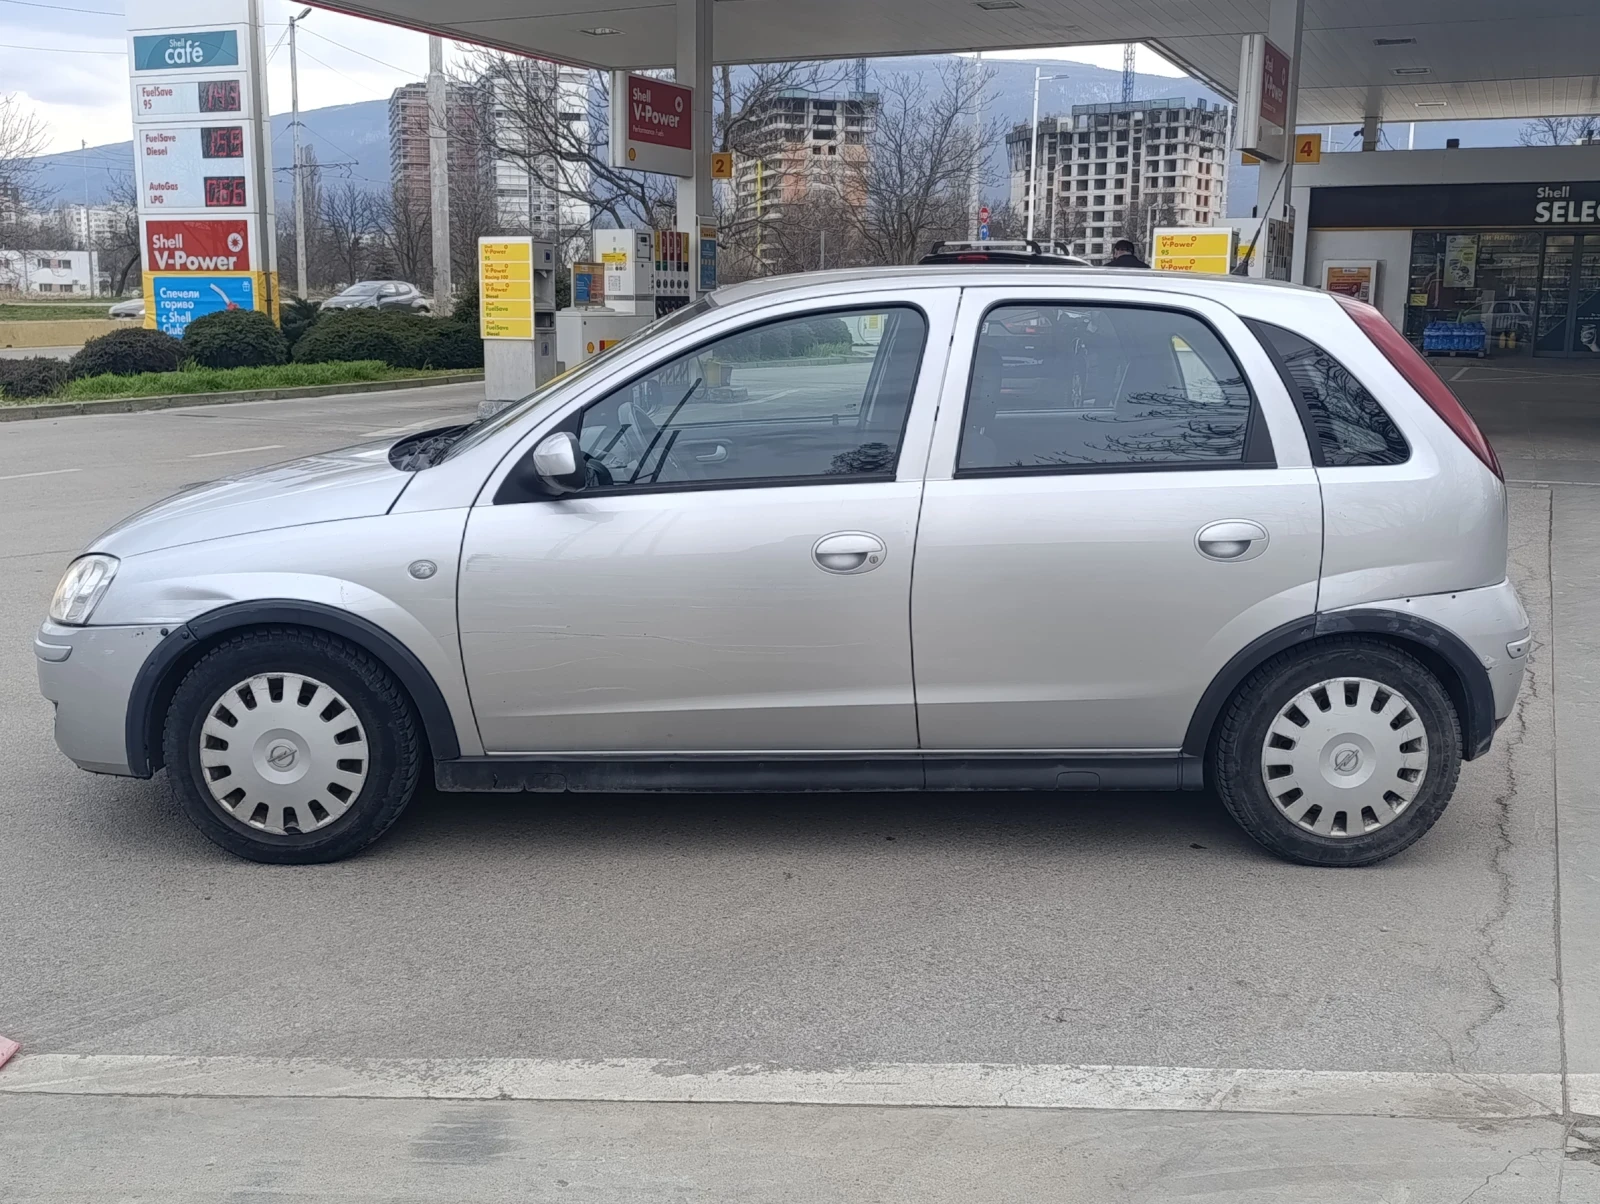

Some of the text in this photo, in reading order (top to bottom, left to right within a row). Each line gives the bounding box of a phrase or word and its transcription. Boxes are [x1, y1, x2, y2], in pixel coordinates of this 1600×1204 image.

[169, 38, 185, 48] Shell
[165, 40, 203, 64] café
[142, 86, 173, 97] FuelSave
[632, 87, 651, 103] Shell
[143, 100, 152, 109] 95
[633, 102, 680, 128] V-Power
[145, 133, 176, 143] FuelSave
[146, 146, 168, 156] Diesel
[1300, 141, 1312, 157] 4
[715, 159, 724, 173] 2
[149, 182, 178, 191] AutoGas
[1536, 185, 1570, 198] Shell
[150, 195, 164, 204] LPG
[1534, 200, 1600, 223] SELE
[152, 233, 183, 249] Shell
[153, 250, 238, 271] V-Power
[160, 287, 200, 298] Спечели
[161, 300, 195, 311] гориво
[161, 311, 192, 323] с Shell
